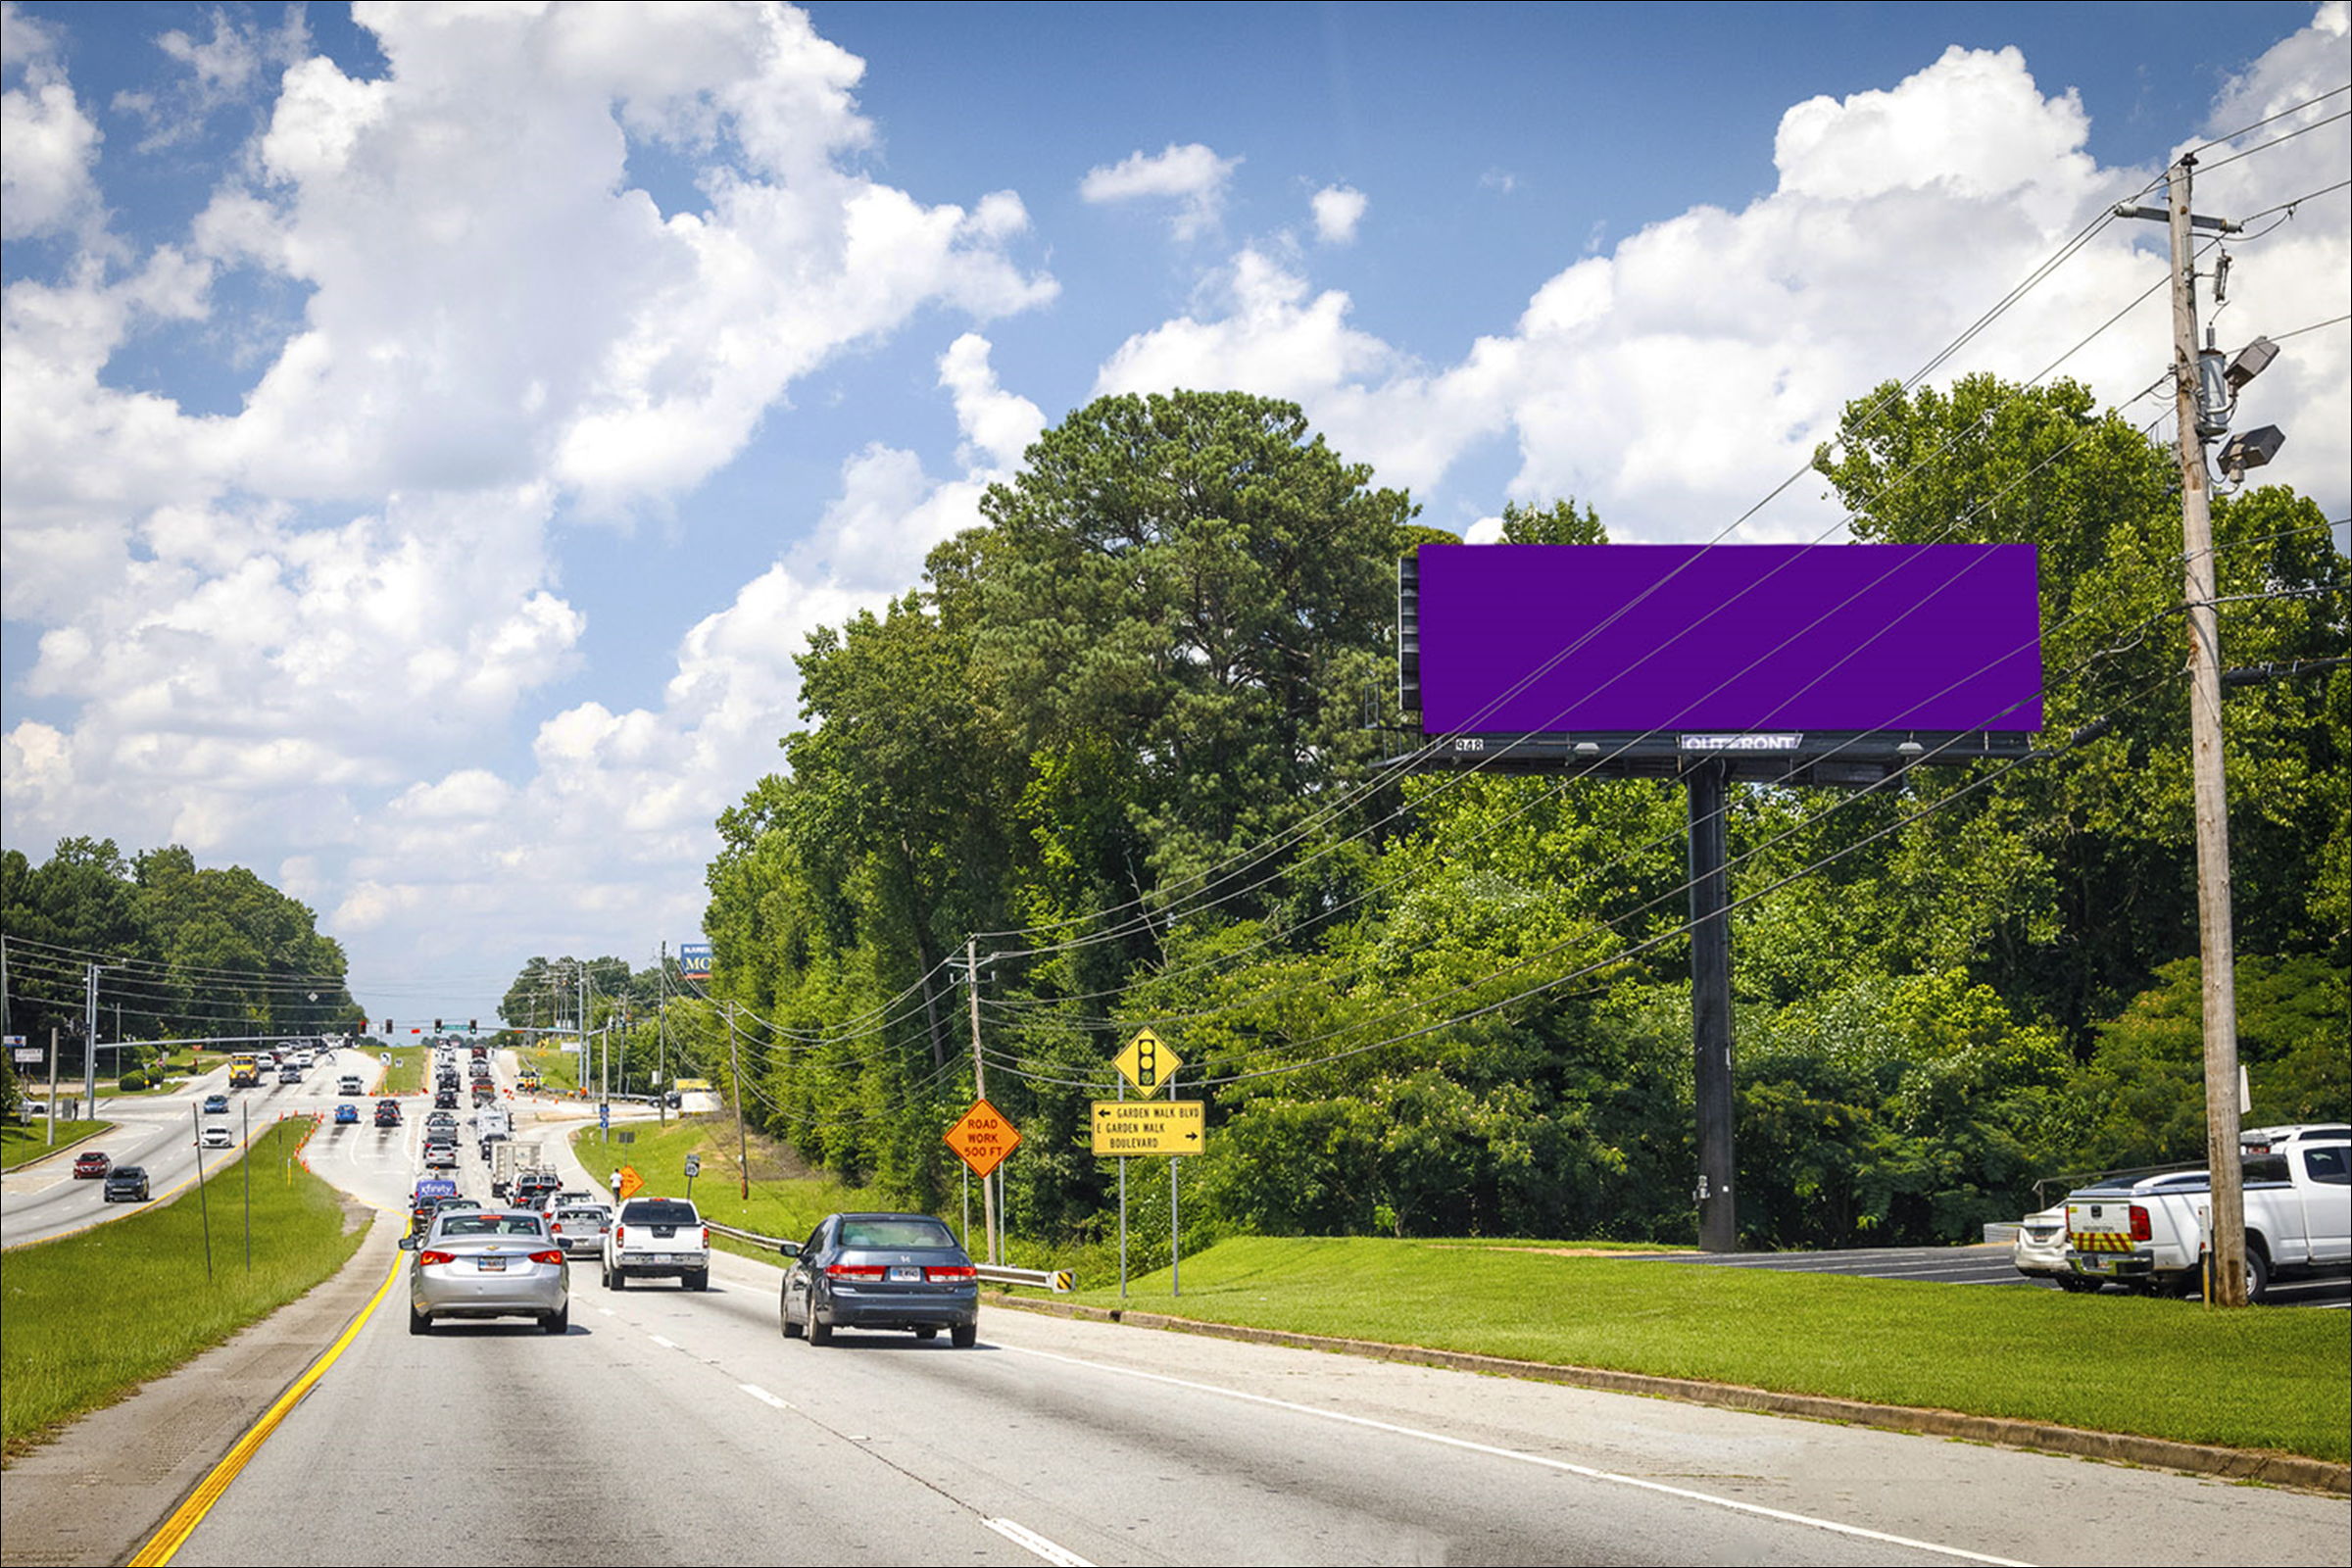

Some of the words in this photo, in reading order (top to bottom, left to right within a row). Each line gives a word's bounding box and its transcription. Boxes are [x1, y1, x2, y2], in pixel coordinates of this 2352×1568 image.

[1117, 1107, 1150, 1118] GARDEN
[1153, 1107, 1175, 1118] WALK
[1179, 1107, 1200, 1118] BLVD
[967, 1118, 998, 1129] ROAD
[1097, 1123, 1102, 1134] E
[1105, 1123, 1139, 1134] GARDEN
[1143, 1123, 1165, 1133] WALK
[967, 1133, 999, 1144] WORK
[1109, 1138, 1159, 1149] BOULEVARD
[964, 1147, 987, 1157] 500
[990, 1147, 1003, 1156] FT
